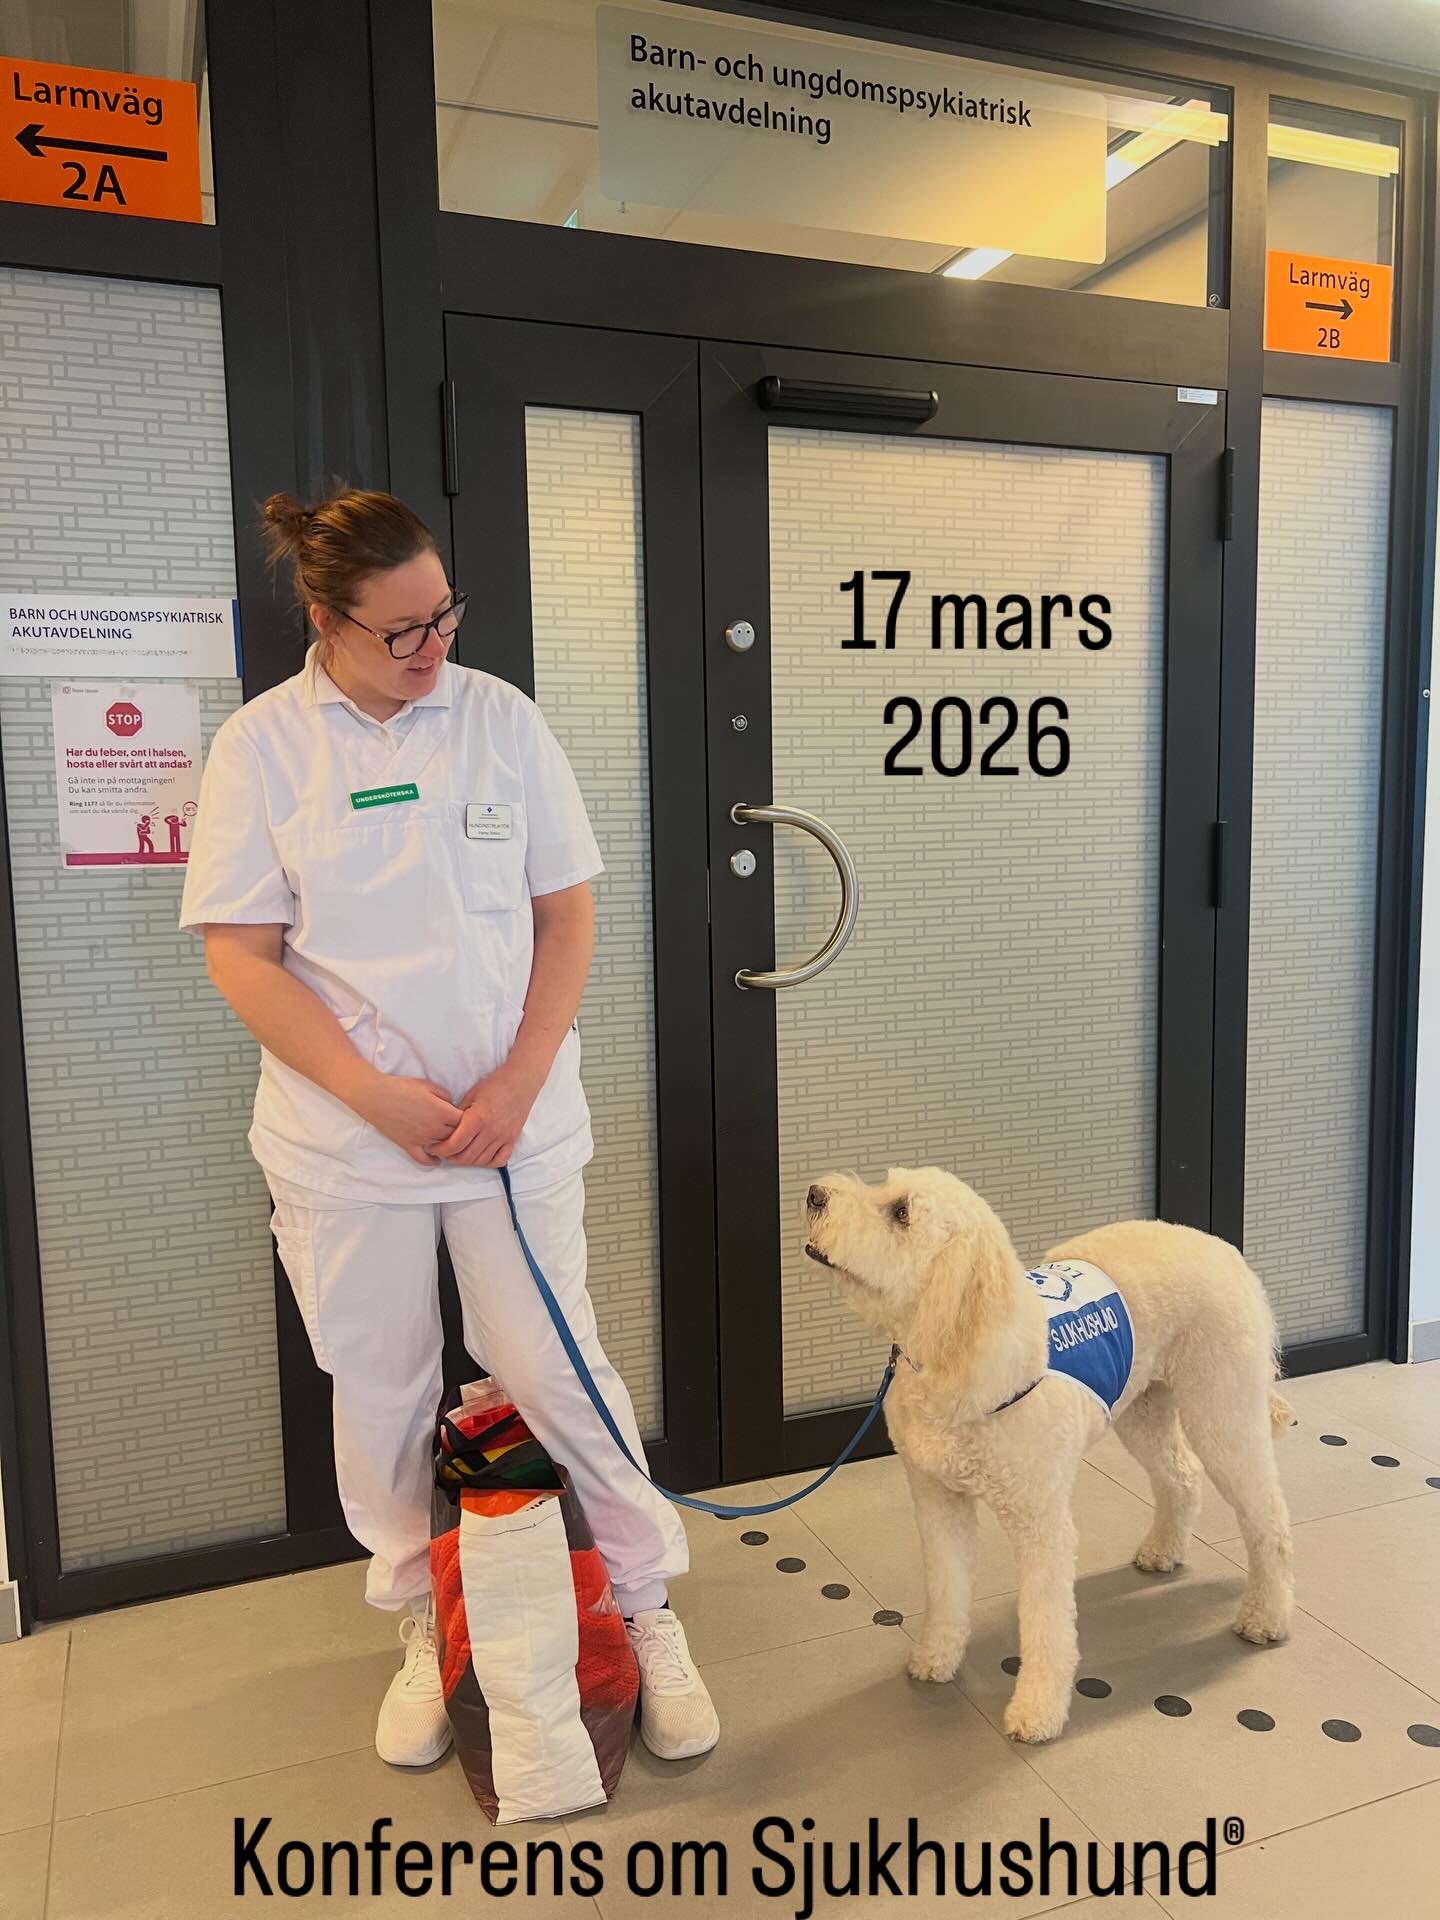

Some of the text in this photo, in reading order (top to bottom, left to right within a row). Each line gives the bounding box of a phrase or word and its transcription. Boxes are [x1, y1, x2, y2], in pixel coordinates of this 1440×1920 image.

[630, 34, 1032, 128] Barn- och ungdomspsykiatrisk
[13, 71, 163, 126] Larmväg
[631, 83, 831, 145] akutavdelning
[62, 161, 127, 206] 2A
[1289, 262, 1370, 299] Larmväg
[1317, 327, 1340, 349] 2B
[9, 608, 224, 624] BARN OCH UNGDOMSPSYKIATRISK
[12, 626, 133, 640] AKUTAVDELNING
[108, 714, 141, 725] STOP
[66, 748, 83, 757] Har
[85, 748, 98, 757] du
[100, 748, 129, 758] feber,
[130, 749, 147, 757] ont
[152, 748, 187, 758] halsen,
[67, 759, 192, 769] hosta eller svårt att andas?
[67, 776, 79, 784] Gå
[107, 777, 117, 786] på
[118, 777, 176, 785] mottagningen!
[68, 786, 149, 794] Du kan smitta andra.
[355, 789, 415, 804] UNDERSKÖTERSKA
[1050, 1306, 1118, 1352] SJUKHUSHUND
